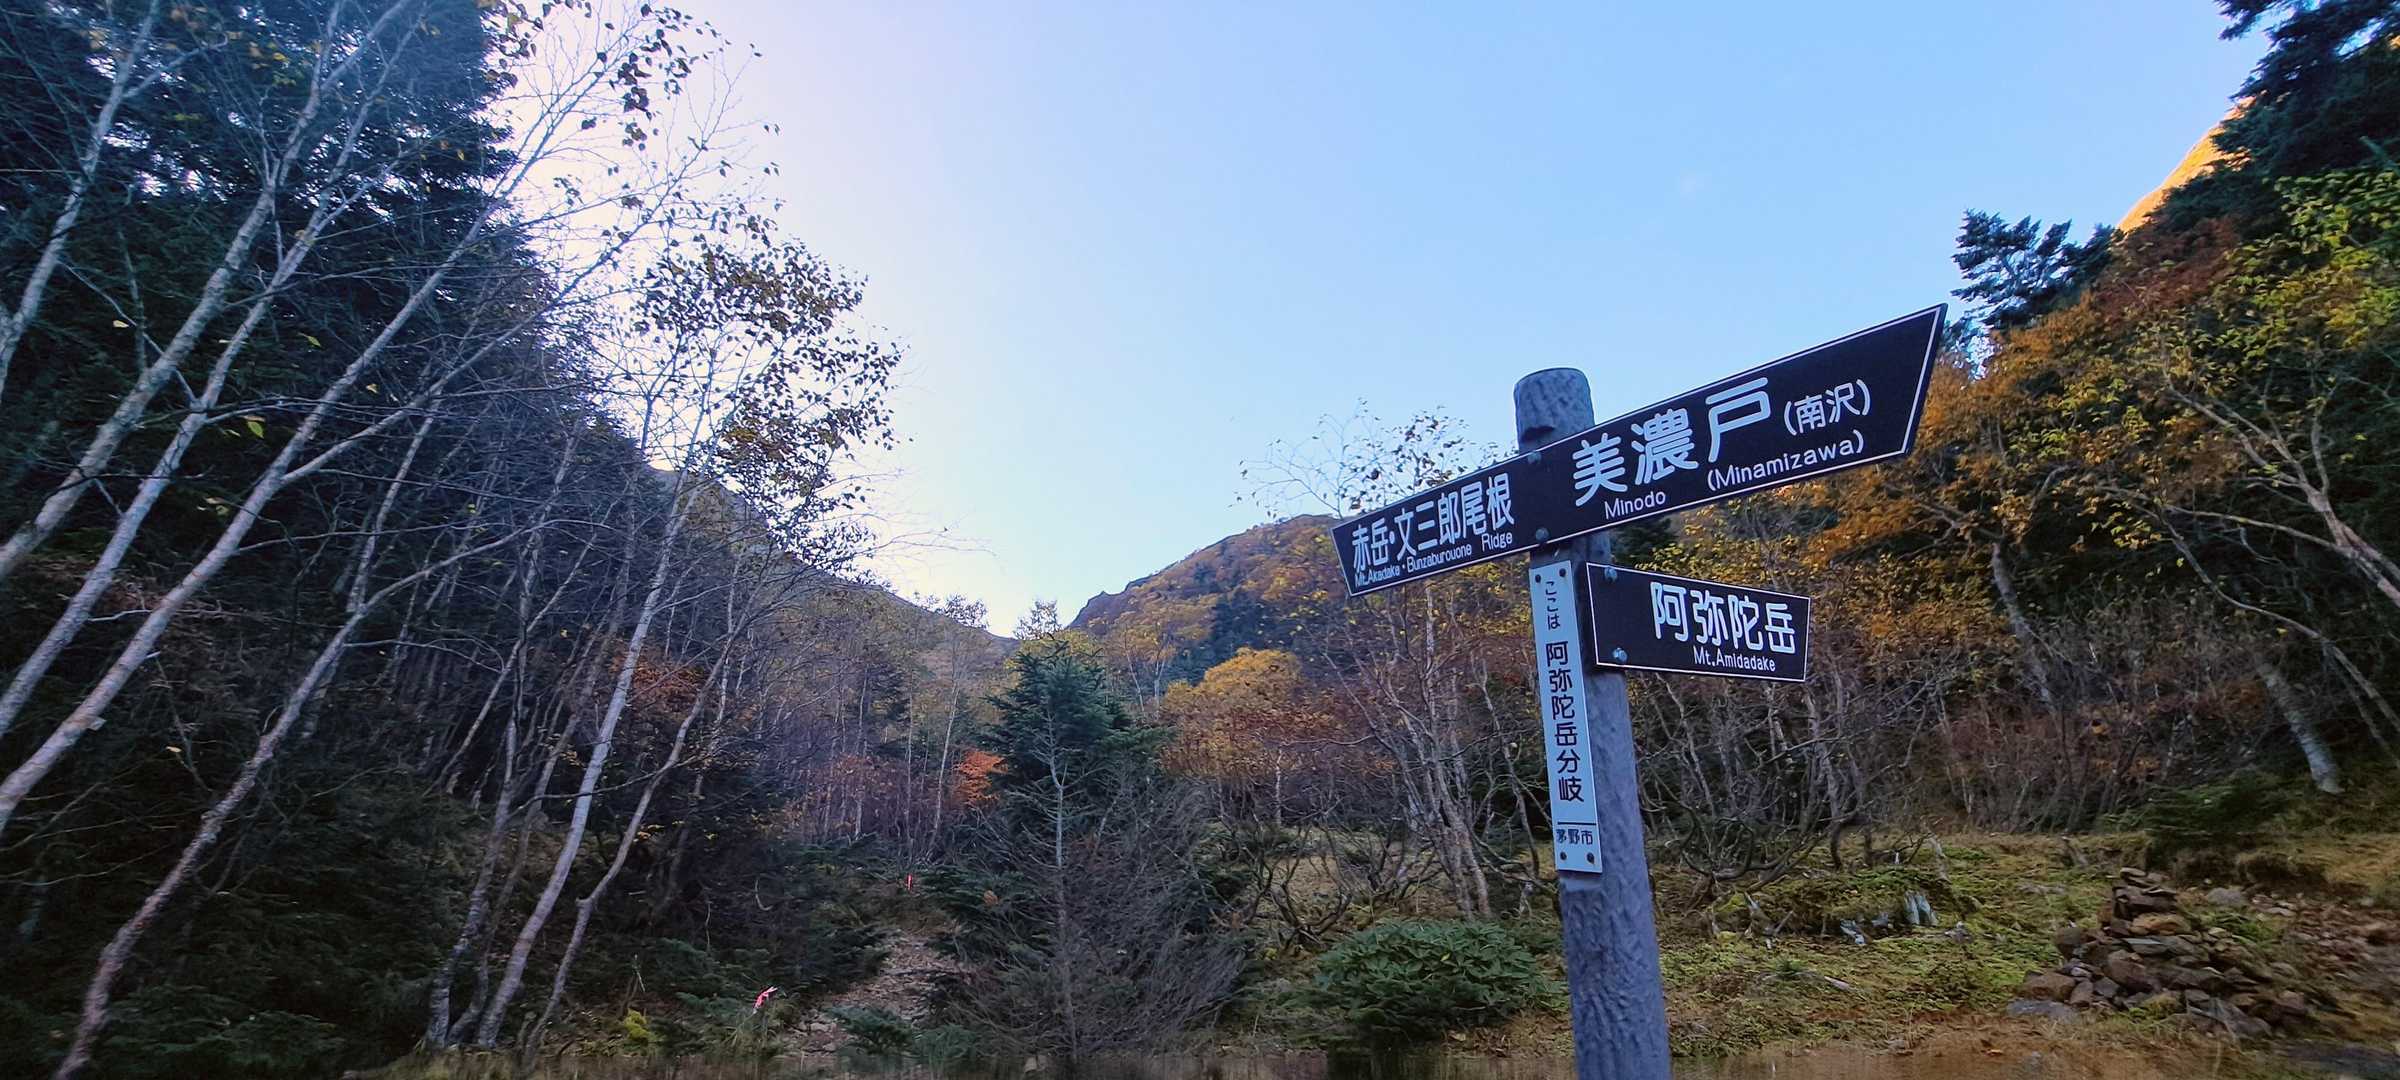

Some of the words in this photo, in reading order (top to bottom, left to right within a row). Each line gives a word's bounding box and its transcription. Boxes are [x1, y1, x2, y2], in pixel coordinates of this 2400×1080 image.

[1572, 377, 1771, 506] 美濃戸
[1783, 379, 1871, 436] (南沢)
[1604, 489, 1666, 521] Minodo
[1707, 430, 1864, 492] (Minamizawa)
[1481, 531, 1513, 552] Ridge
[1545, 580, 1561, 630] ここは
[1650, 581, 1796, 654] 阿弥陀岳
[1693, 645, 1776, 673] Mt.Amidadake
[1545, 640, 1584, 803] 阿弥陀岳分岐
